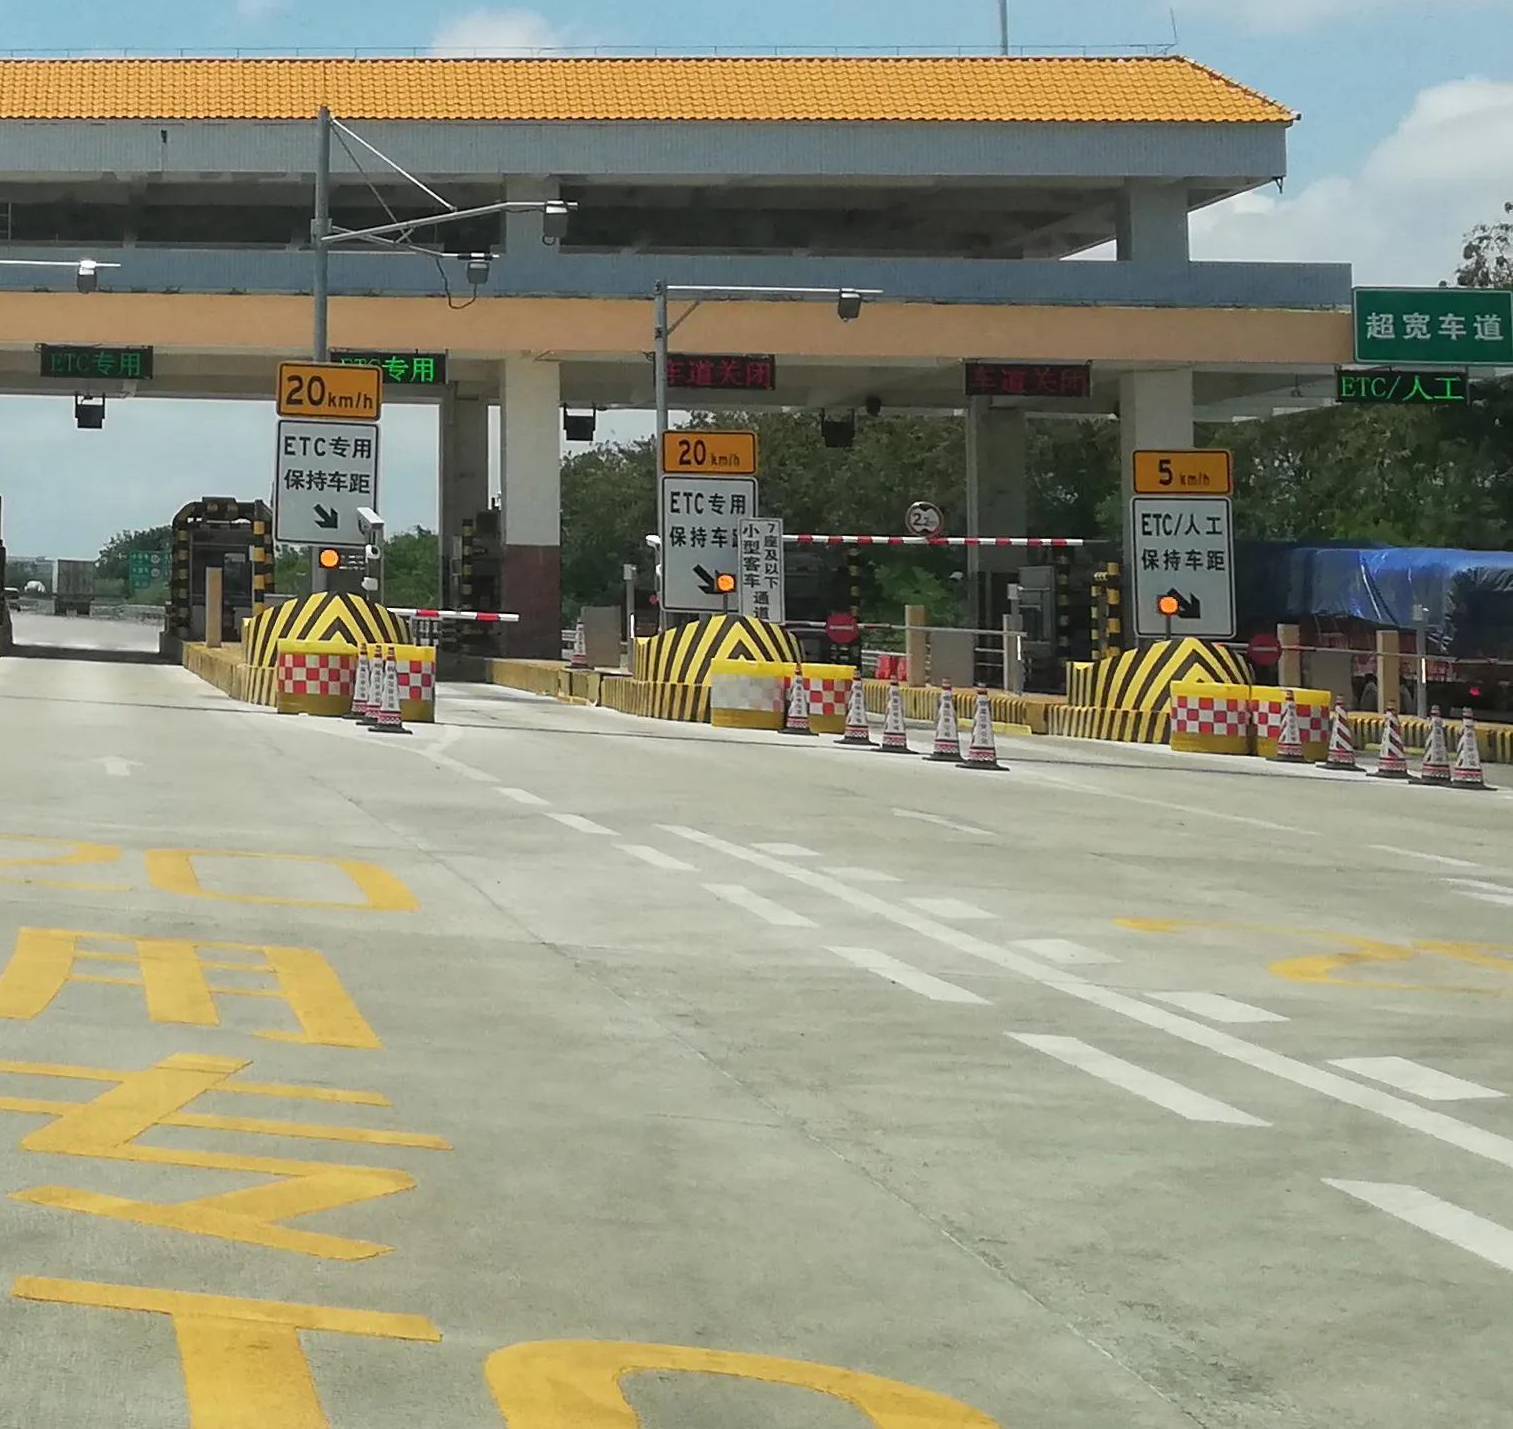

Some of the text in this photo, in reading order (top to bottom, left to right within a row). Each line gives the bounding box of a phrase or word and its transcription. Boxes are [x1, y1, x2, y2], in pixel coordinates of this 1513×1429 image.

[1366, 312, 1504, 341] 超宽车道
[1341, 375, 1464, 401] ETC/人工
[284, 469, 370, 494] 保持车距
[1141, 513, 1223, 536] ETC/人工
[743, 523, 761, 588] 小型客车
[1141, 549, 1225, 571] 保持车距
[753, 591, 769, 620] 通道
